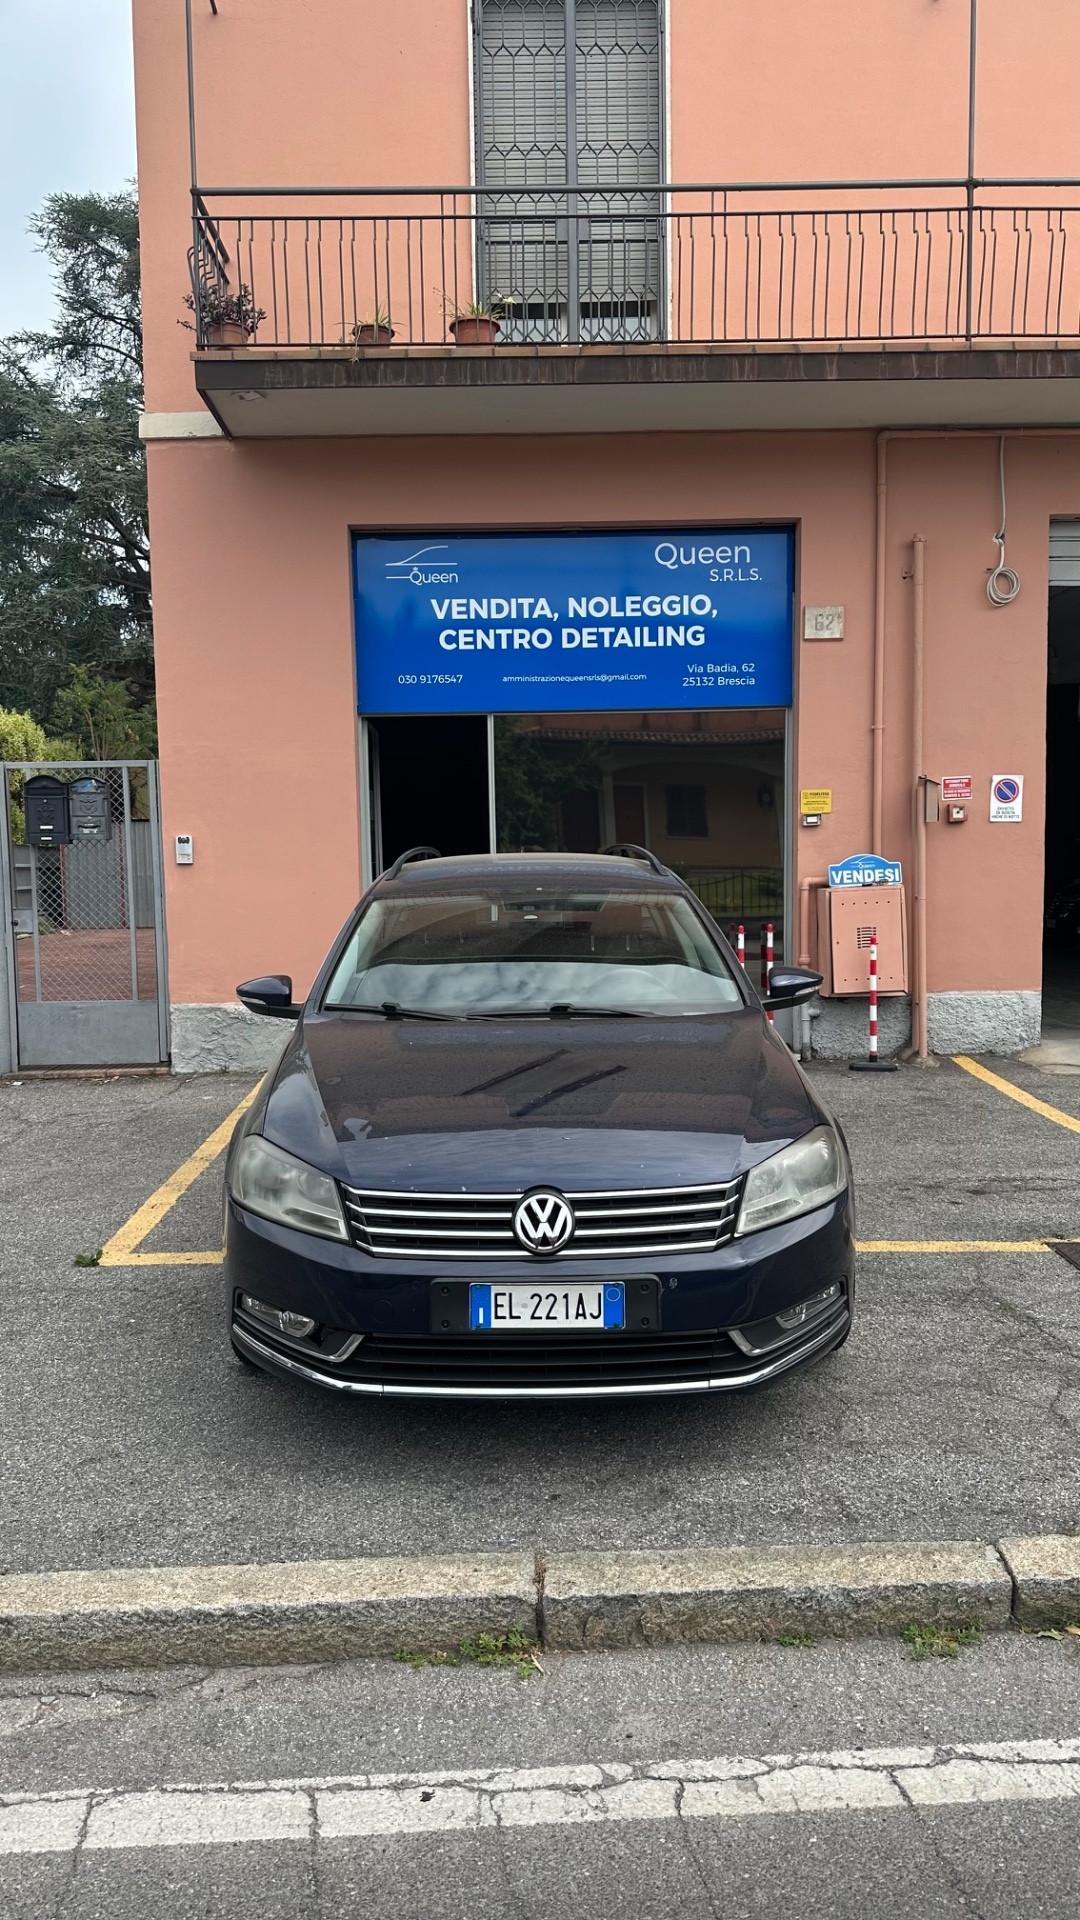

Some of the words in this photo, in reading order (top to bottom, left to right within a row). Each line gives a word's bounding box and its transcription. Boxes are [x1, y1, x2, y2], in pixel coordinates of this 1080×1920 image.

[654, 542, 751, 570] Queen
[409, 569, 459, 586] Queen
[709, 567, 763, 582] S.R.L.S.
[430, 597, 559, 622] VENDITA,
[568, 593, 718, 619] NOLEGGIO,
[438, 627, 553, 650] CENTRO
[561, 625, 706, 649] DETAILING
[687, 663, 704, 673] Via
[706, 663, 739, 674] Badia,
[741, 663, 755, 673] 62
[398, 674, 417, 684] 030
[419, 674, 463, 684] 9176547
[502, 673, 647, 684] amministrazionequeensrls@gmail.com
[682, 677, 715, 687] 25132
[717, 676, 756, 686] Brescia
[831, 867, 900, 884] VENDESI
[493, 1292, 522, 1320] EL
[529, 1292, 602, 1320] 221AJ
